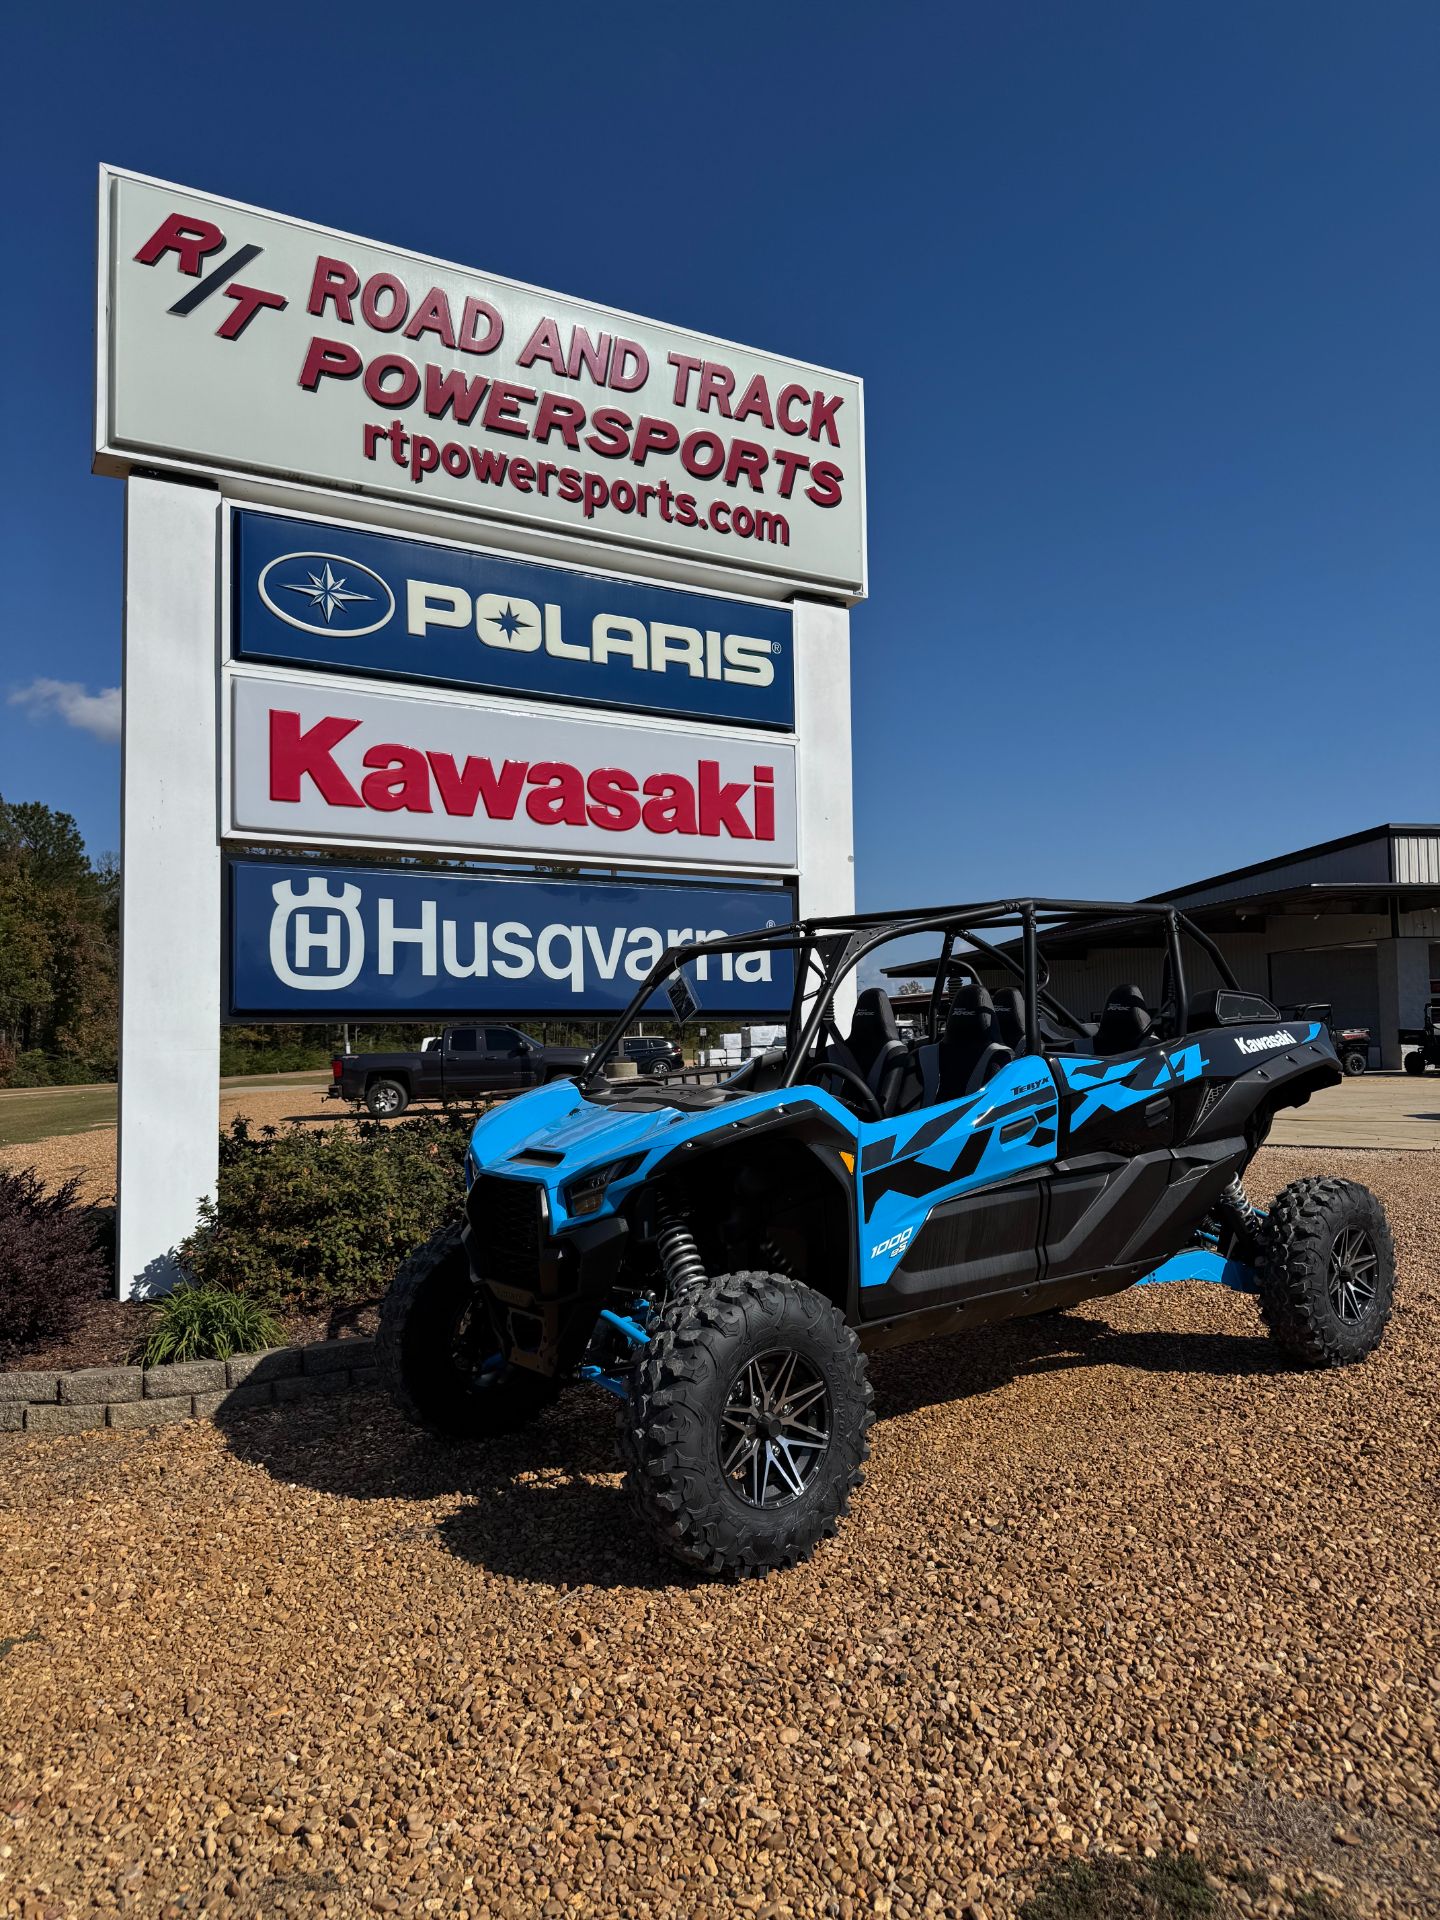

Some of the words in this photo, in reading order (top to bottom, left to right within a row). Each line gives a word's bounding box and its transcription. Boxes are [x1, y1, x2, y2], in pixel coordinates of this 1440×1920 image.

[308, 254, 503, 355] ROAD
[518, 315, 650, 392] AND
[666, 350, 845, 448] TRACK
[299, 335, 845, 509] POWERSPORTS
[363, 418, 792, 546] rtpowersports.com
[406, 579, 775, 687] POLARIS
[268, 707, 777, 842] Kawasaki
[377, 896, 774, 994] Husqvarna
[1234, 1030, 1297, 1055] Kawasaki
[870, 1226, 914, 1259] 1000
